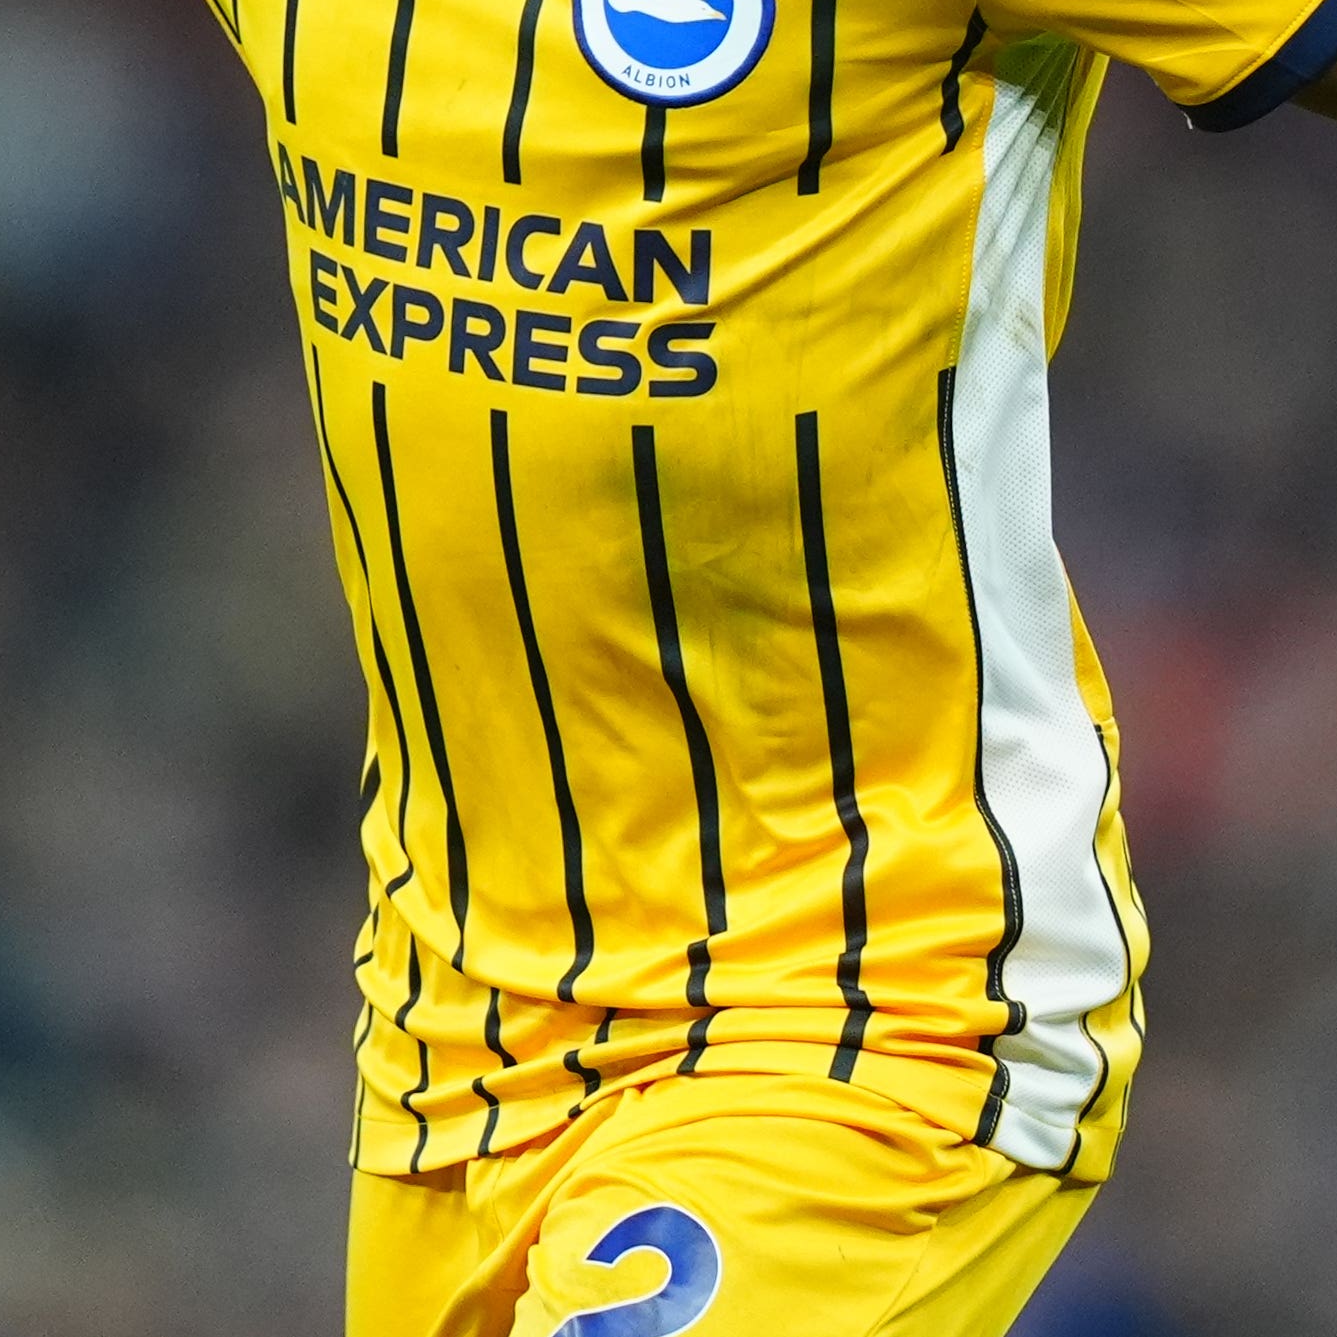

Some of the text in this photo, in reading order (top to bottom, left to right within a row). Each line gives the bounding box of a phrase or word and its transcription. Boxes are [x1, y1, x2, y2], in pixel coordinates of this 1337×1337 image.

[621, 64, 691, 89] ALBION
[277, 141, 712, 306] AMERICAN
[309, 248, 718, 398] EXPRESS
[548, 1202, 723, 1337] 2
